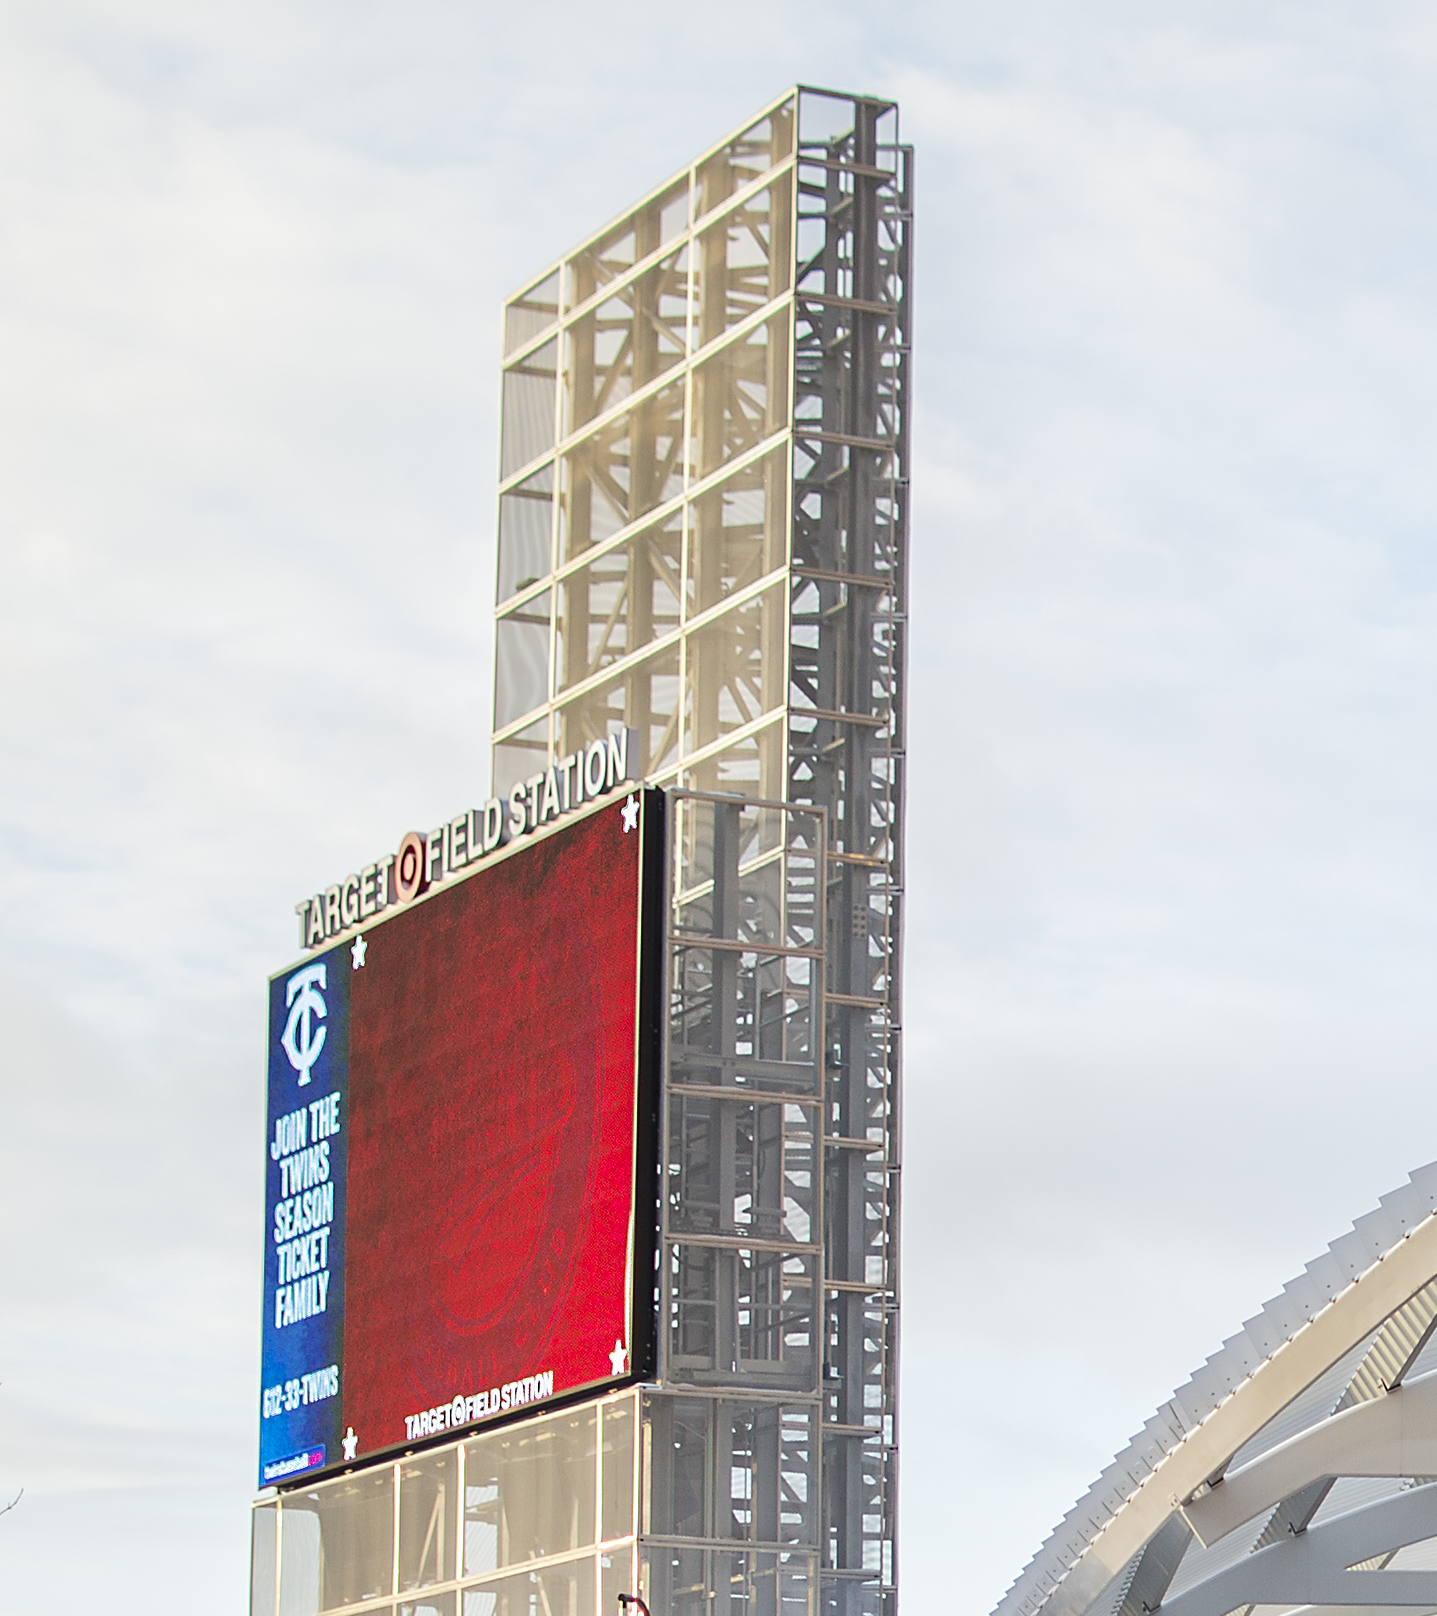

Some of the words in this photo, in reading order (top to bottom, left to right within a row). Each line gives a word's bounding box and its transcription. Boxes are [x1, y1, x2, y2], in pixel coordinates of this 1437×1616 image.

[295, 853, 396, 949] TARGET
[425, 797, 506, 883] FIELD
[508, 726, 633, 837] STATION
[270, 1107, 308, 1161] JOIN
[308, 1091, 341, 1143] THE
[279, 1140, 331, 1198] TWINS
[273, 1181, 334, 1244] SEASON
[276, 1226, 331, 1286] TICKET
[275, 1270, 331, 1329] FAMILY
[263, 1364, 339, 1419] 612-33-TWINS
[404, 1404, 452, 1440] TARGET
[465, 1387, 500, 1422] FIELD
[501, 1370, 554, 1410] STATION
